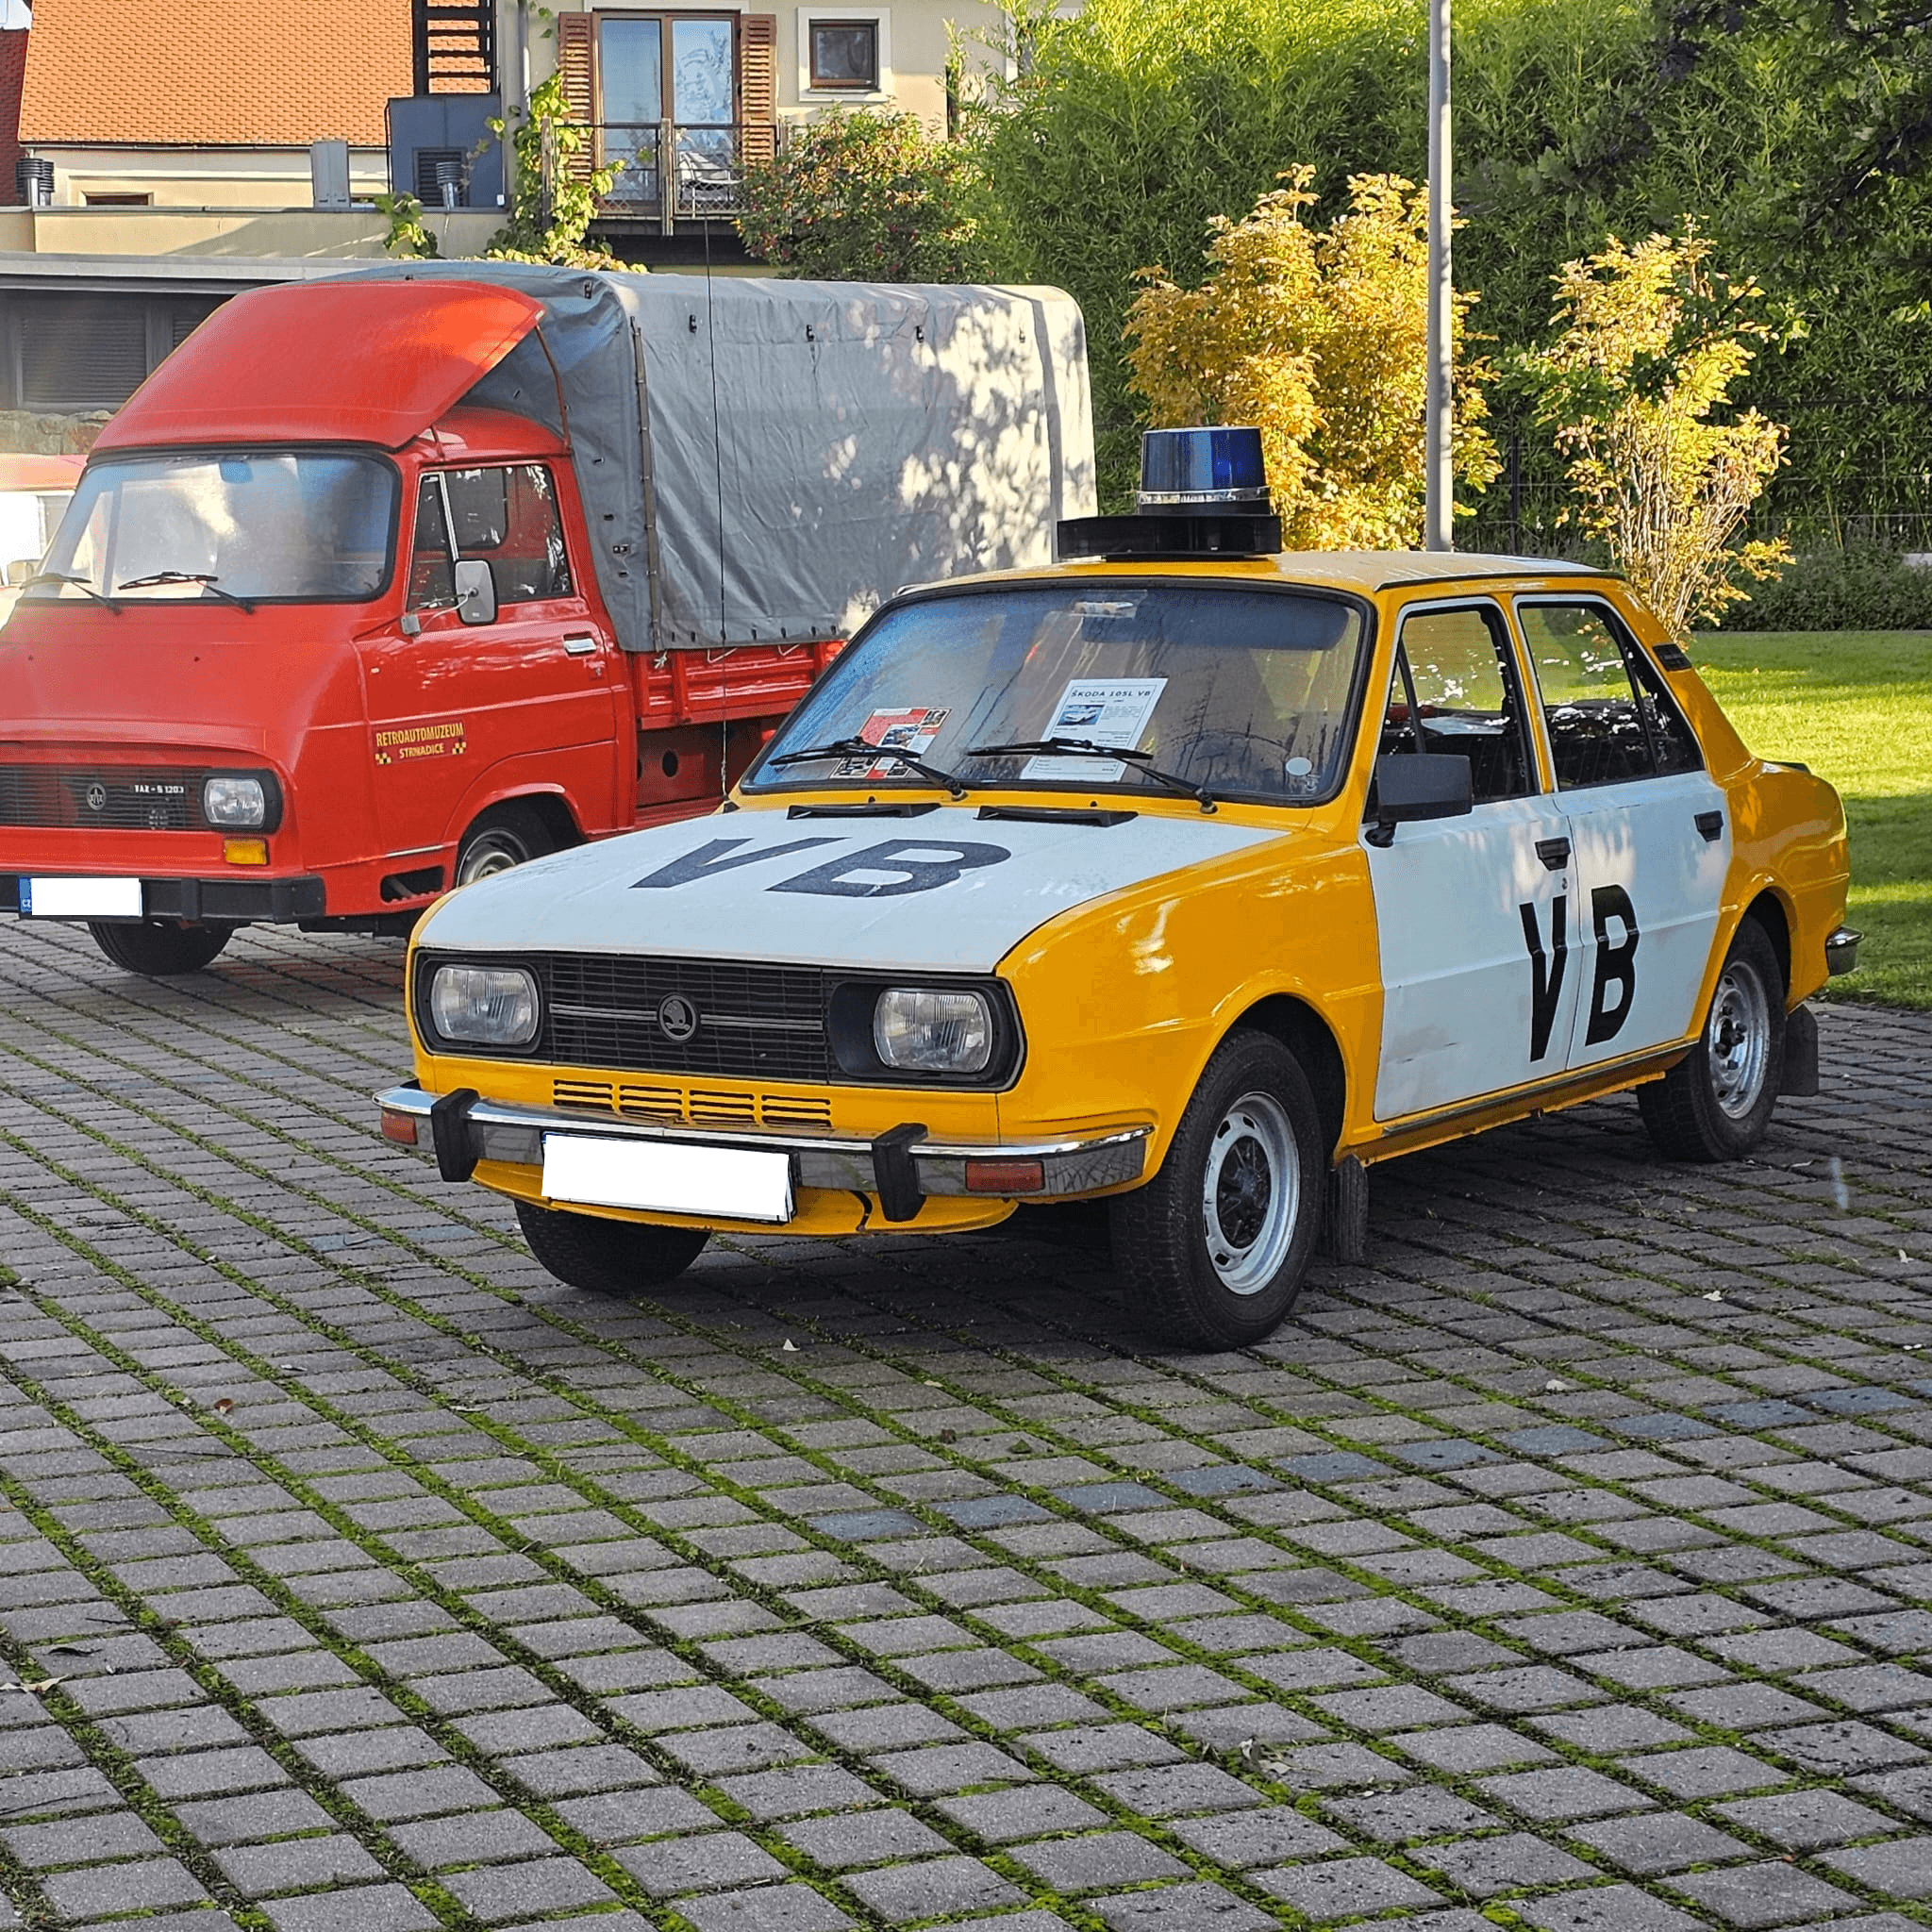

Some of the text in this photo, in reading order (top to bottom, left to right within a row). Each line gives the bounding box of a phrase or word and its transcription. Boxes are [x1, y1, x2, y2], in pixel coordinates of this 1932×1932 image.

[1071, 689, 1106, 697] ŠKODA
[376, 722, 464, 747] RETROAUTOMUZEUM
[399, 742, 444, 758] STRNADICE
[164, 785, 185, 793] 1203
[628, 837, 1012, 897] VB
[1519, 884, 1640, 1062] VB
